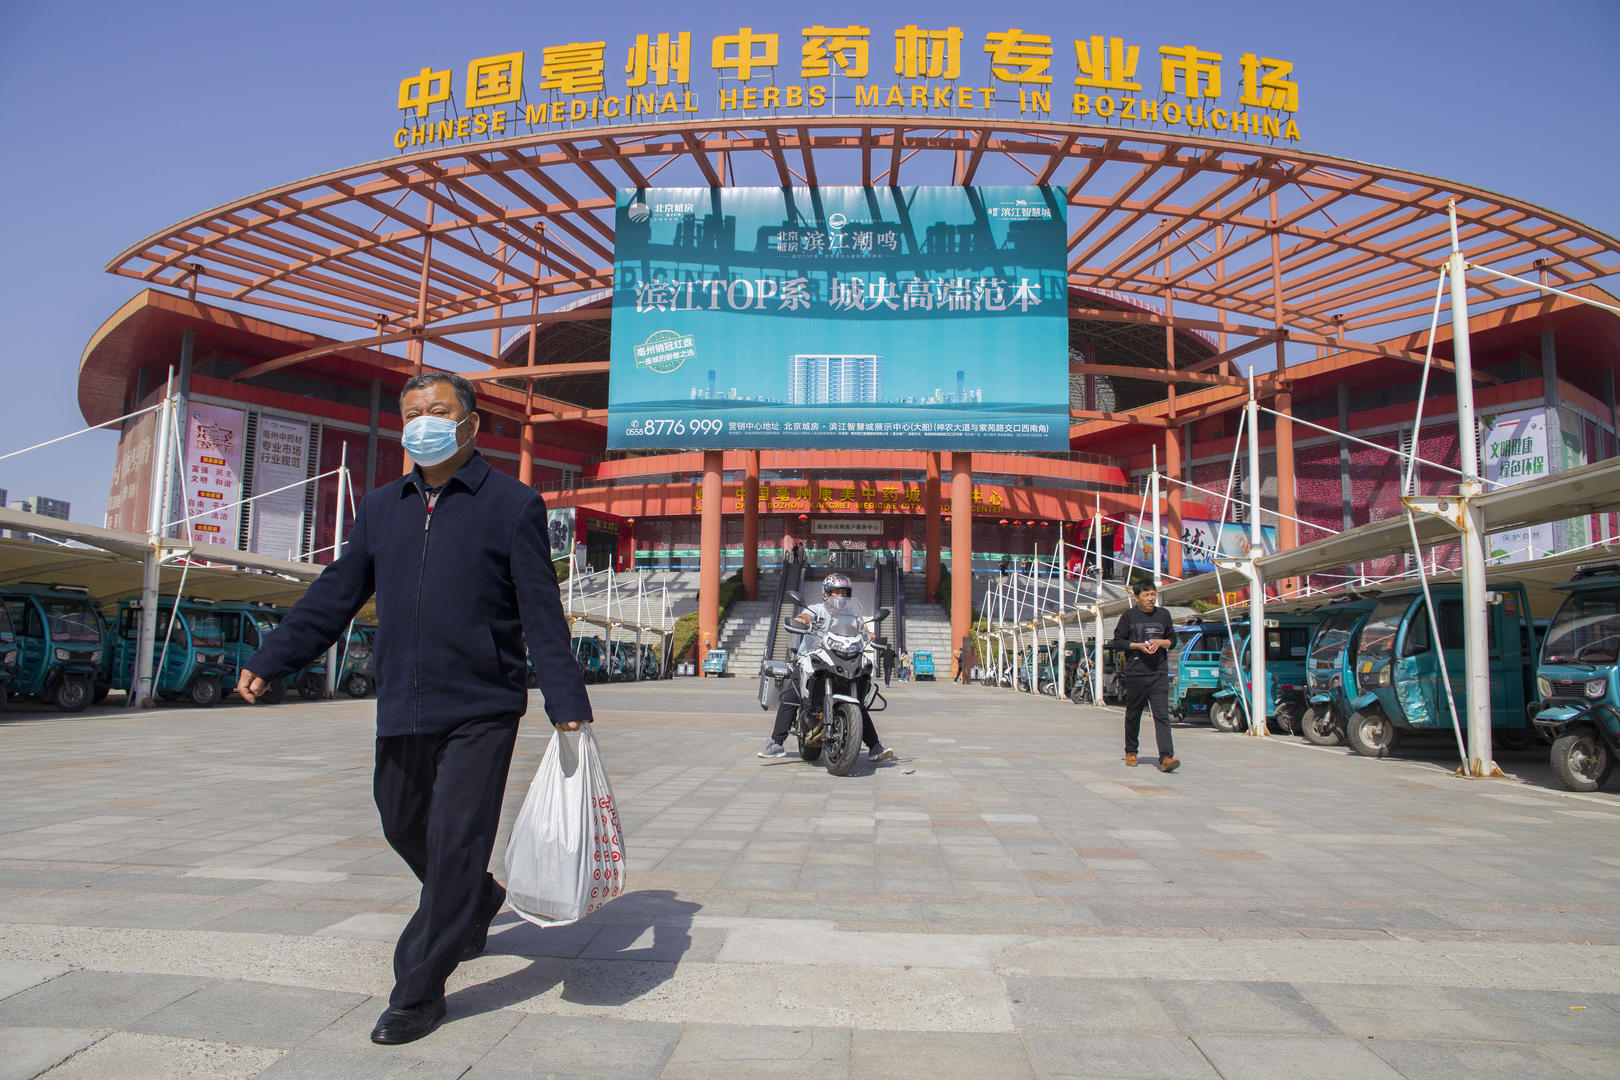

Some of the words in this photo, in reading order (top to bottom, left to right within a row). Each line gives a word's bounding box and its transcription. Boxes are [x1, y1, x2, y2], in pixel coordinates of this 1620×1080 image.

[398, 24, 1300, 119] 中国亳州中药材专业市场
[394, 110, 506, 149] CHINESE
[525, 90, 699, 125] MEDICINAL
[720, 85, 826, 110] HERBS
[855, 85, 995, 109] MARKET
[1020, 91, 1051, 113] IN
[777, 231, 798, 240] 北京
[803, 230, 897, 251] 滨江潮鸣
[635, 277, 811, 313] 滨江TOP系
[829, 276, 1043, 312] 城央高端范本
[626, 428, 644, 436] 0558
[644, 419, 685, 435] 8776
[689, 419, 723, 435] 999
[262, 441, 302, 456] 专业市场
[1490, 436, 1533, 459] 文明健康
[261, 452, 301, 468] 行业规范
[191, 475, 208, 484] 文明
[216, 468, 233, 478] 民主
[856, 502, 898, 510] MEDICINE
[901, 502, 922, 510] CITY
